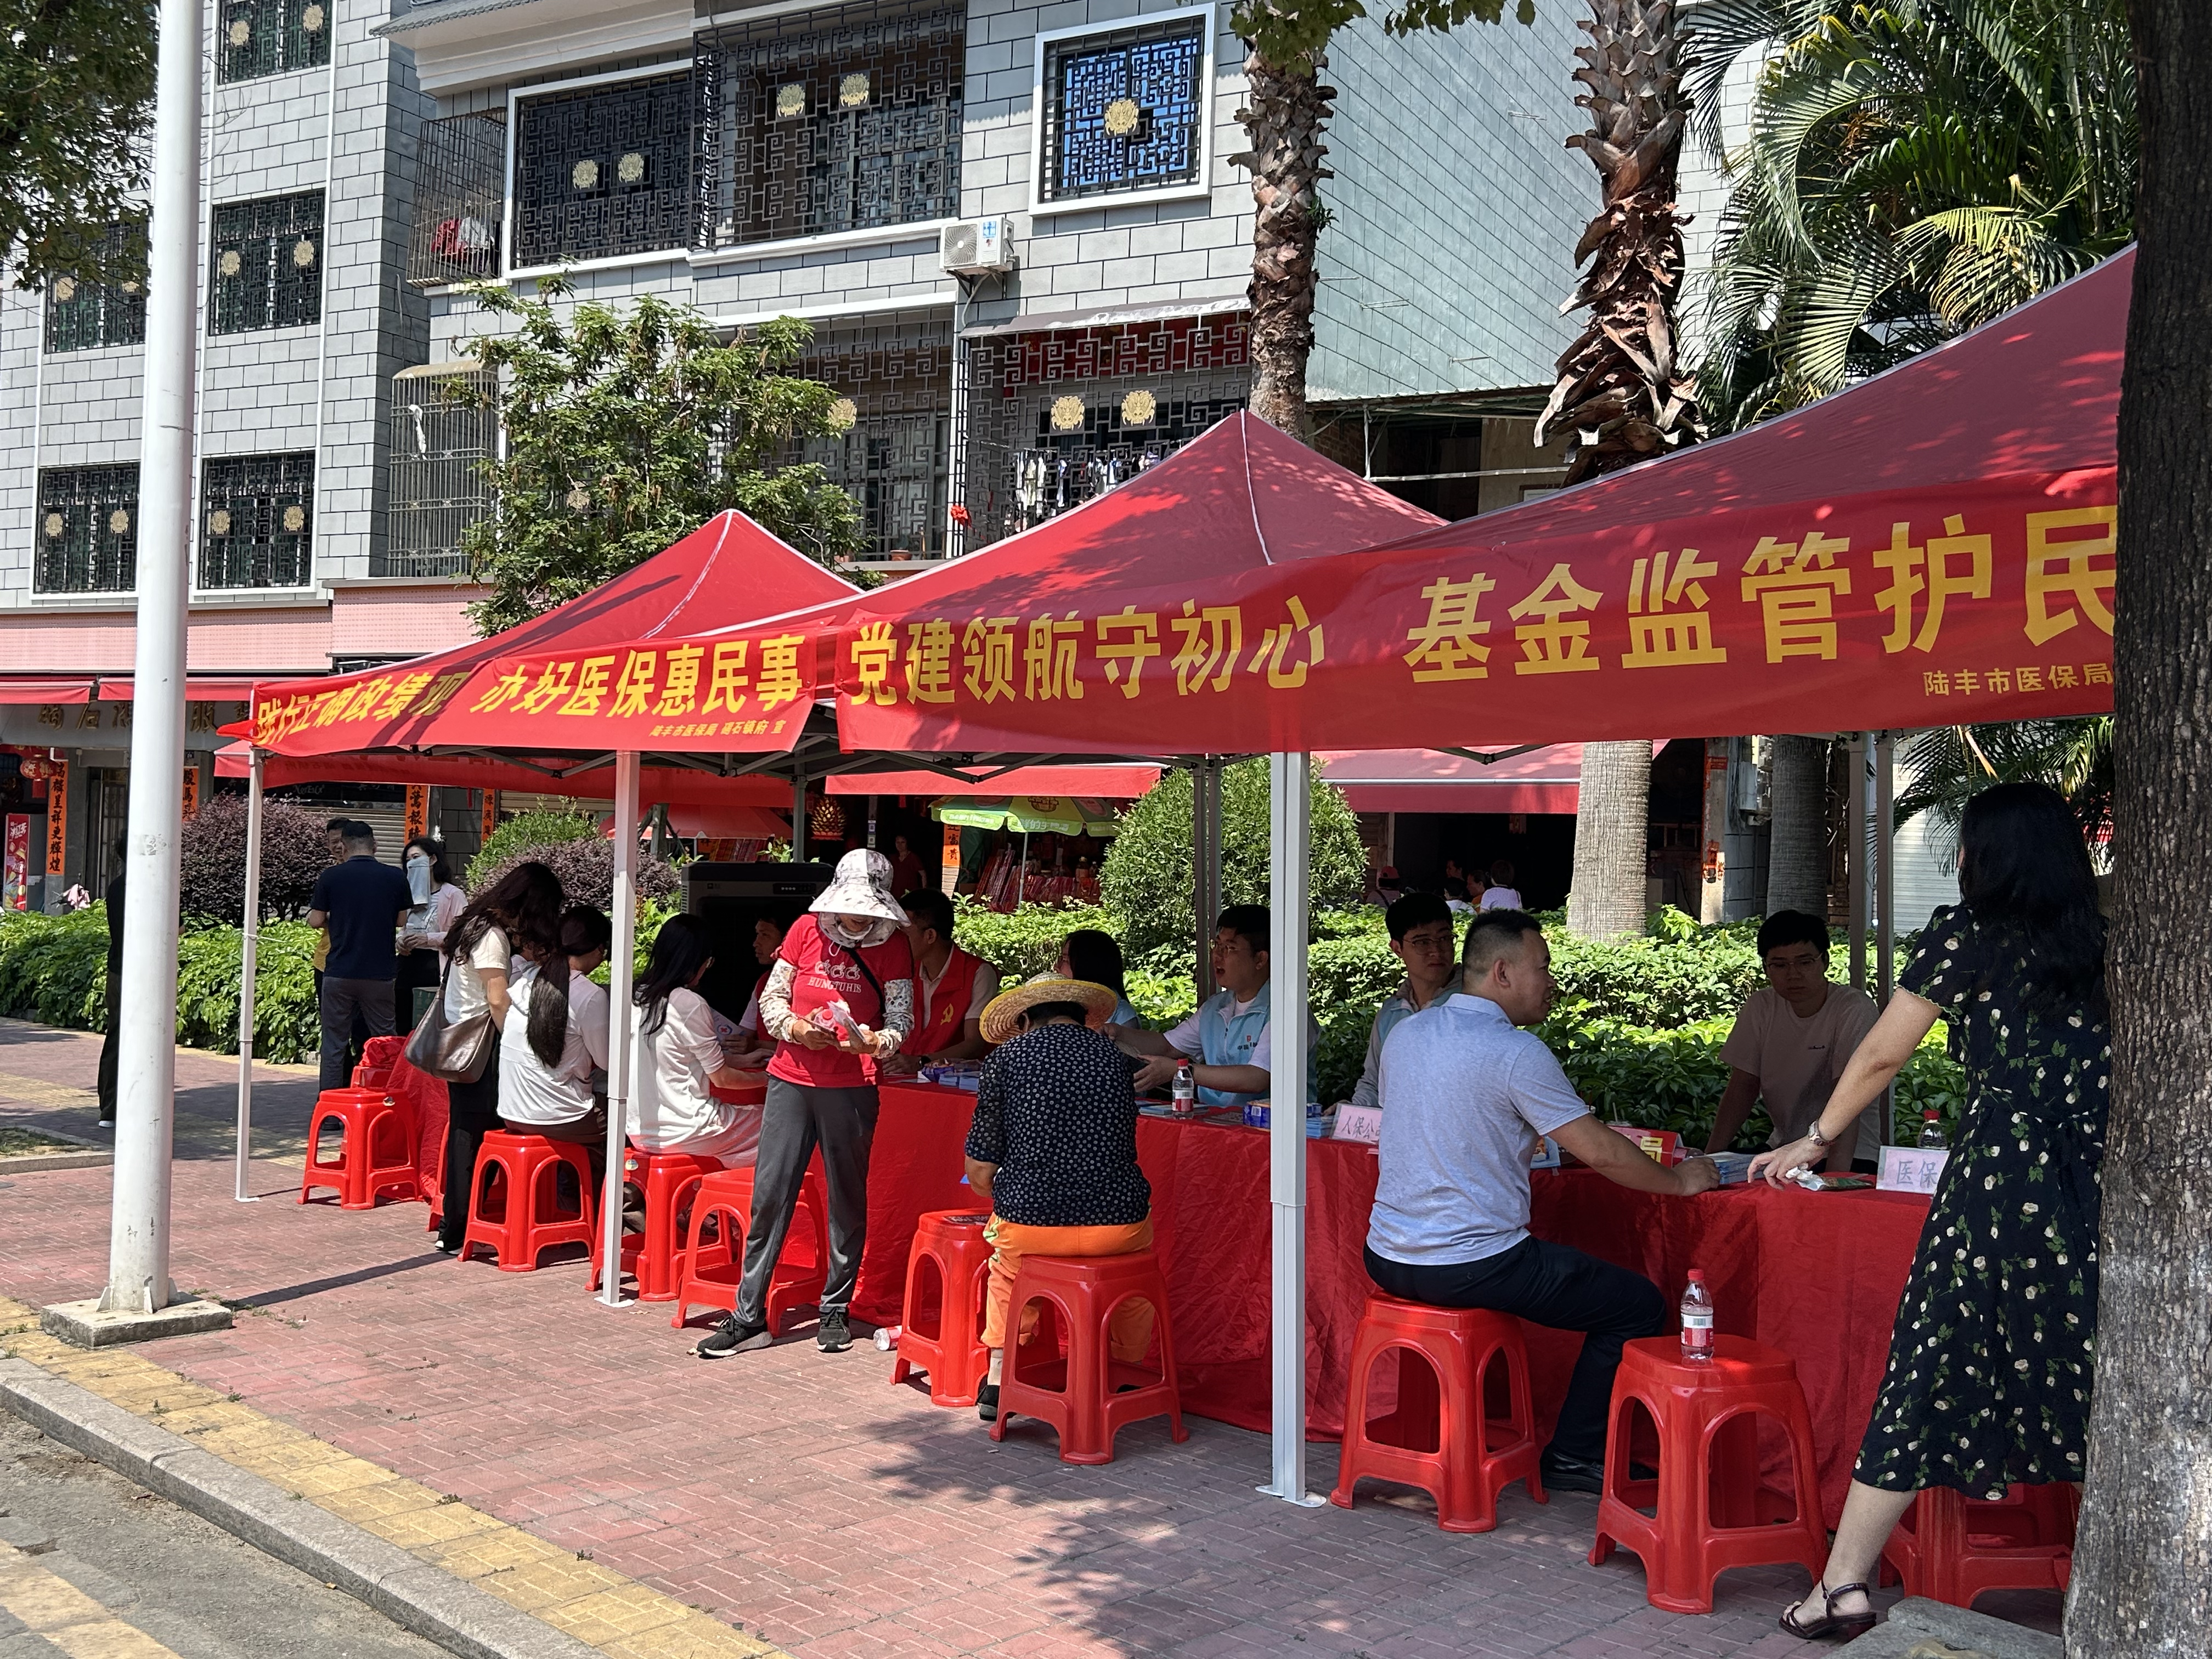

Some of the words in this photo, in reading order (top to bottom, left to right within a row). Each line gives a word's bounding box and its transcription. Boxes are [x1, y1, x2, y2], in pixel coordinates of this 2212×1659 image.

[850, 594, 1325, 706] 党建领航守初心
[1402, 504, 2118, 684] 基金监管护民
[470, 633, 806, 719] 办好医保惠民事
[1922, 662, 2114, 697] 陆丰市医保局
[1896, 1158, 1938, 1189] 医保
